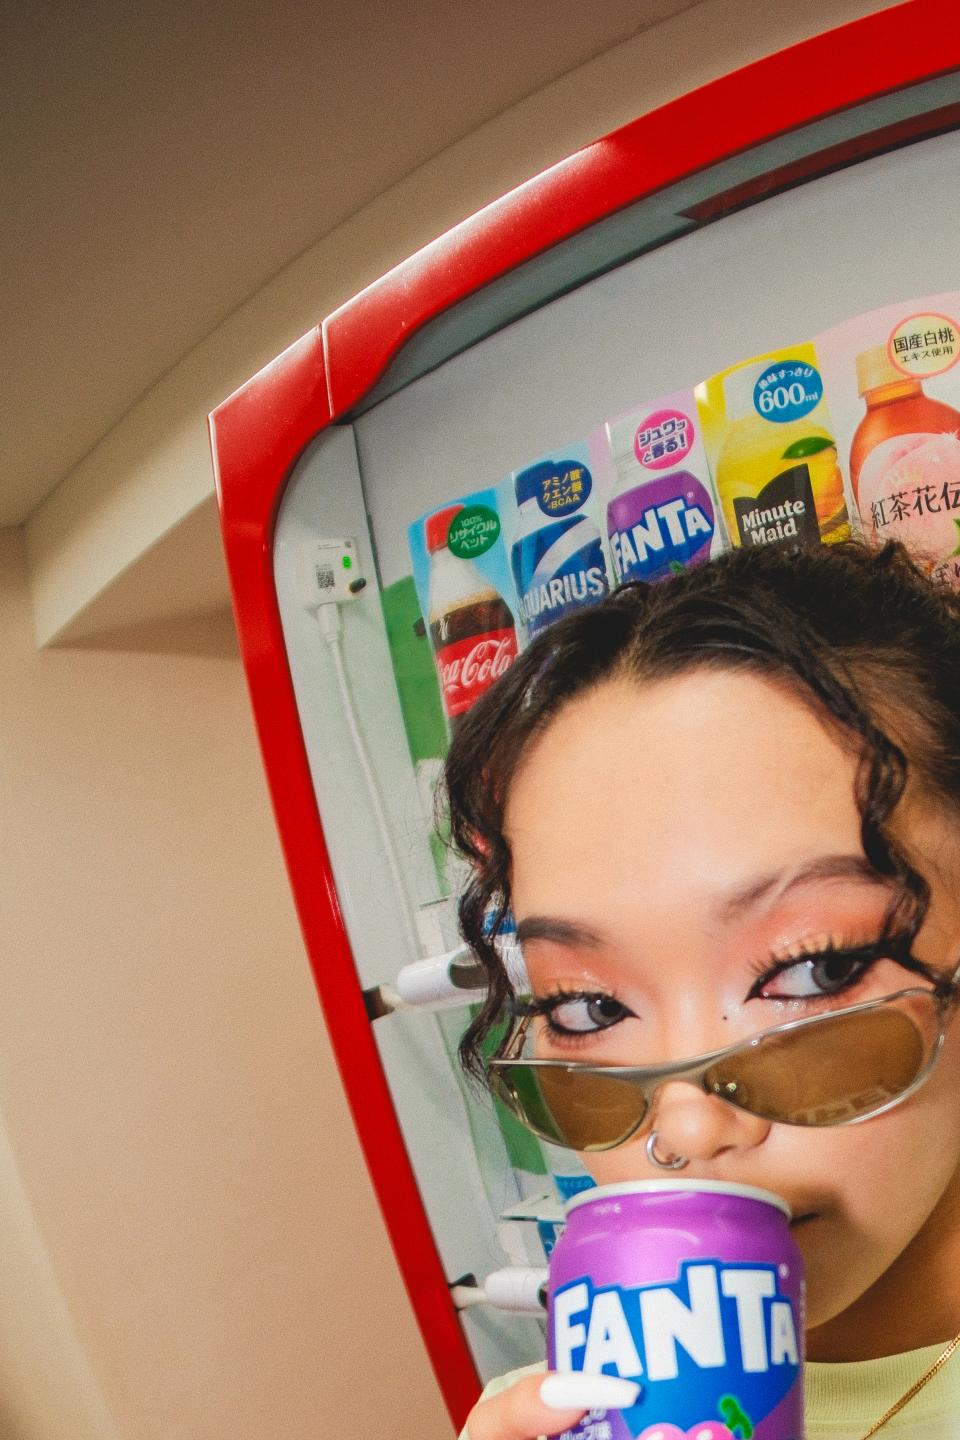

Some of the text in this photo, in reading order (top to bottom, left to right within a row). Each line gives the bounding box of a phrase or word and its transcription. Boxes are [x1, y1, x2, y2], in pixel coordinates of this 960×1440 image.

[893, 327, 955, 354] 国産白桃
[902, 346, 953, 363] エキス使用
[639, 417, 686, 447] ジュワッ
[741, 500, 806, 531] Minute
[610, 497, 712, 578] FANTA
[751, 518, 798, 546] Maid
[553, 1264, 799, 1381] FANTA
